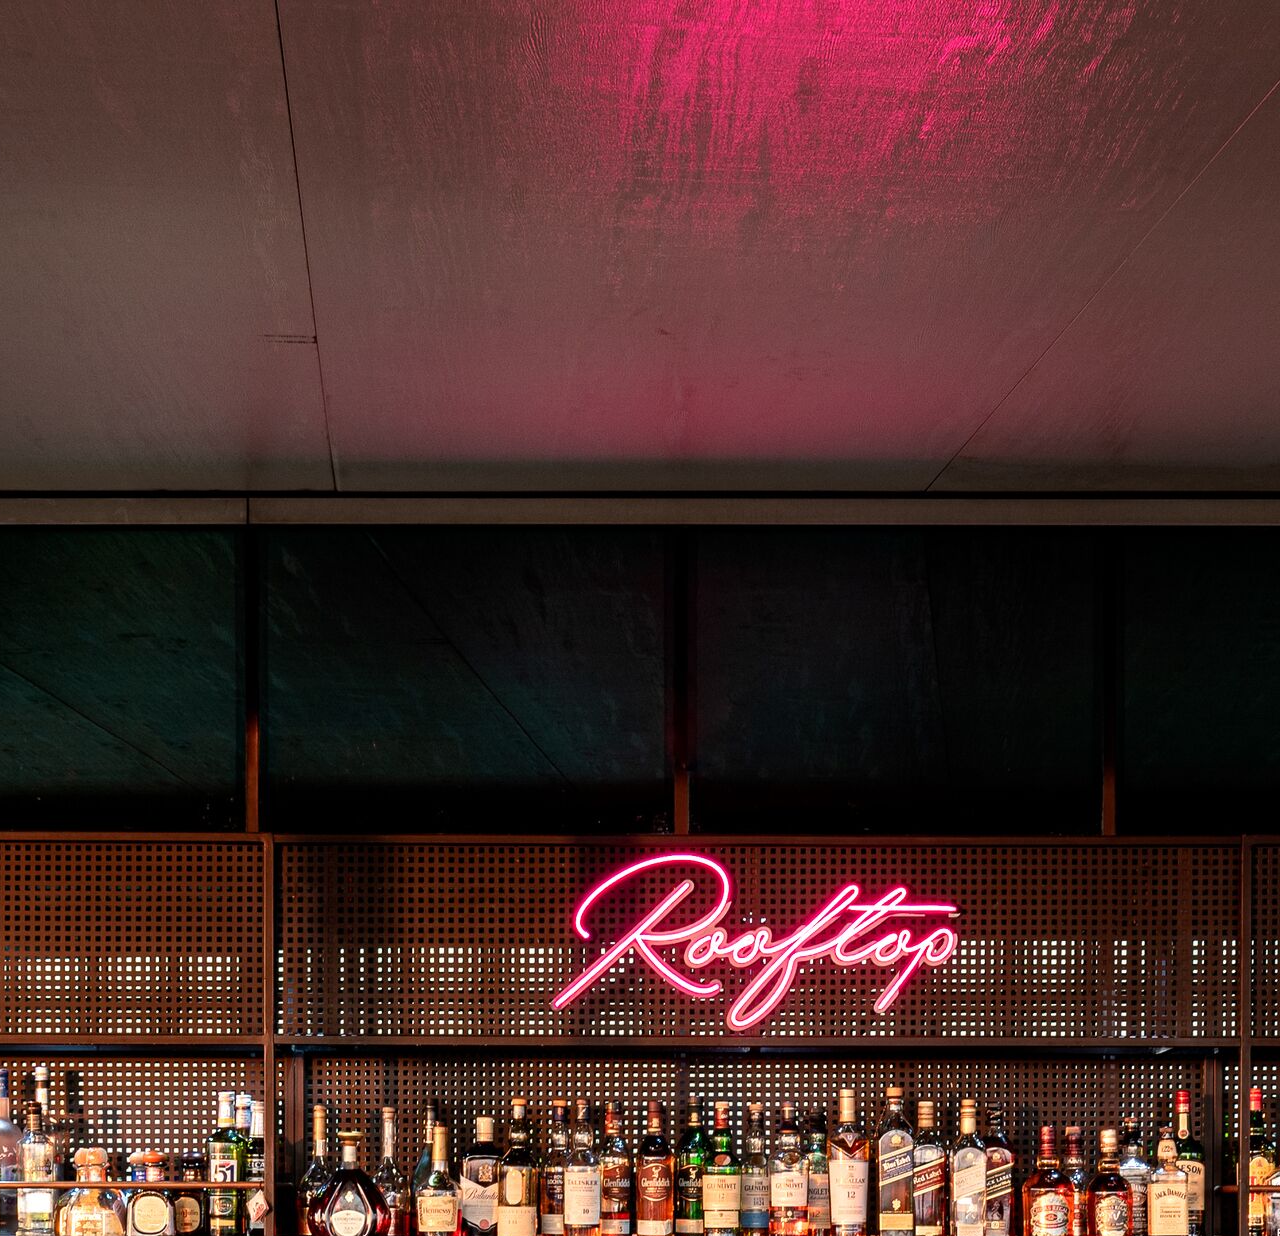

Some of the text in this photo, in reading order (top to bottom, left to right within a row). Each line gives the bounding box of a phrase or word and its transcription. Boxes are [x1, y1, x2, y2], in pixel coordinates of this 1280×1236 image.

[552, 854, 960, 1031] Rooftop
[214, 1166, 235, 1182] 51
[913, 1173, 926, 1185] Red
[925, 1168, 942, 1180] Label
[1178, 1163, 1202, 1176] ESON
[464, 1187, 501, 1201] Ballantin
[847, 1191, 856, 1199] 12
[422, 1206, 451, 1216] Hennessy
